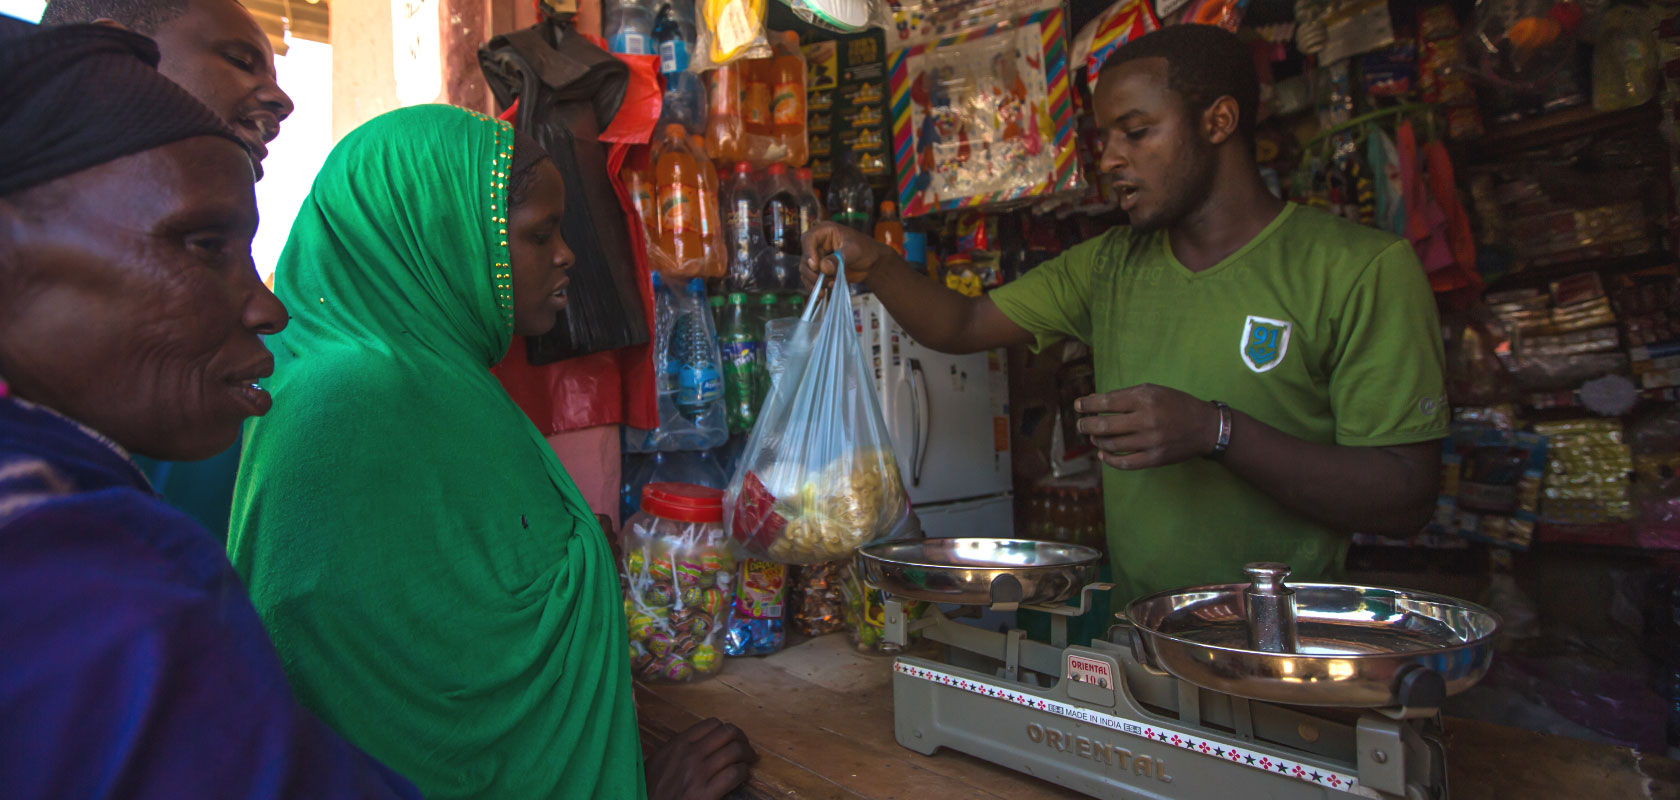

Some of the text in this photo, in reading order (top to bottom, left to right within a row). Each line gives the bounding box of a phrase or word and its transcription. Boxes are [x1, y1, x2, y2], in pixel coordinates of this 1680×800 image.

[1252, 326, 1278, 349] 91
[1071, 660, 1108, 675] ORIENTAL
[1066, 708, 1088, 720] MADE
[1089, 714, 1098, 723] IN
[1099, 717, 1122, 729] INDIA
[1027, 721, 1173, 783] ORIENTAL
